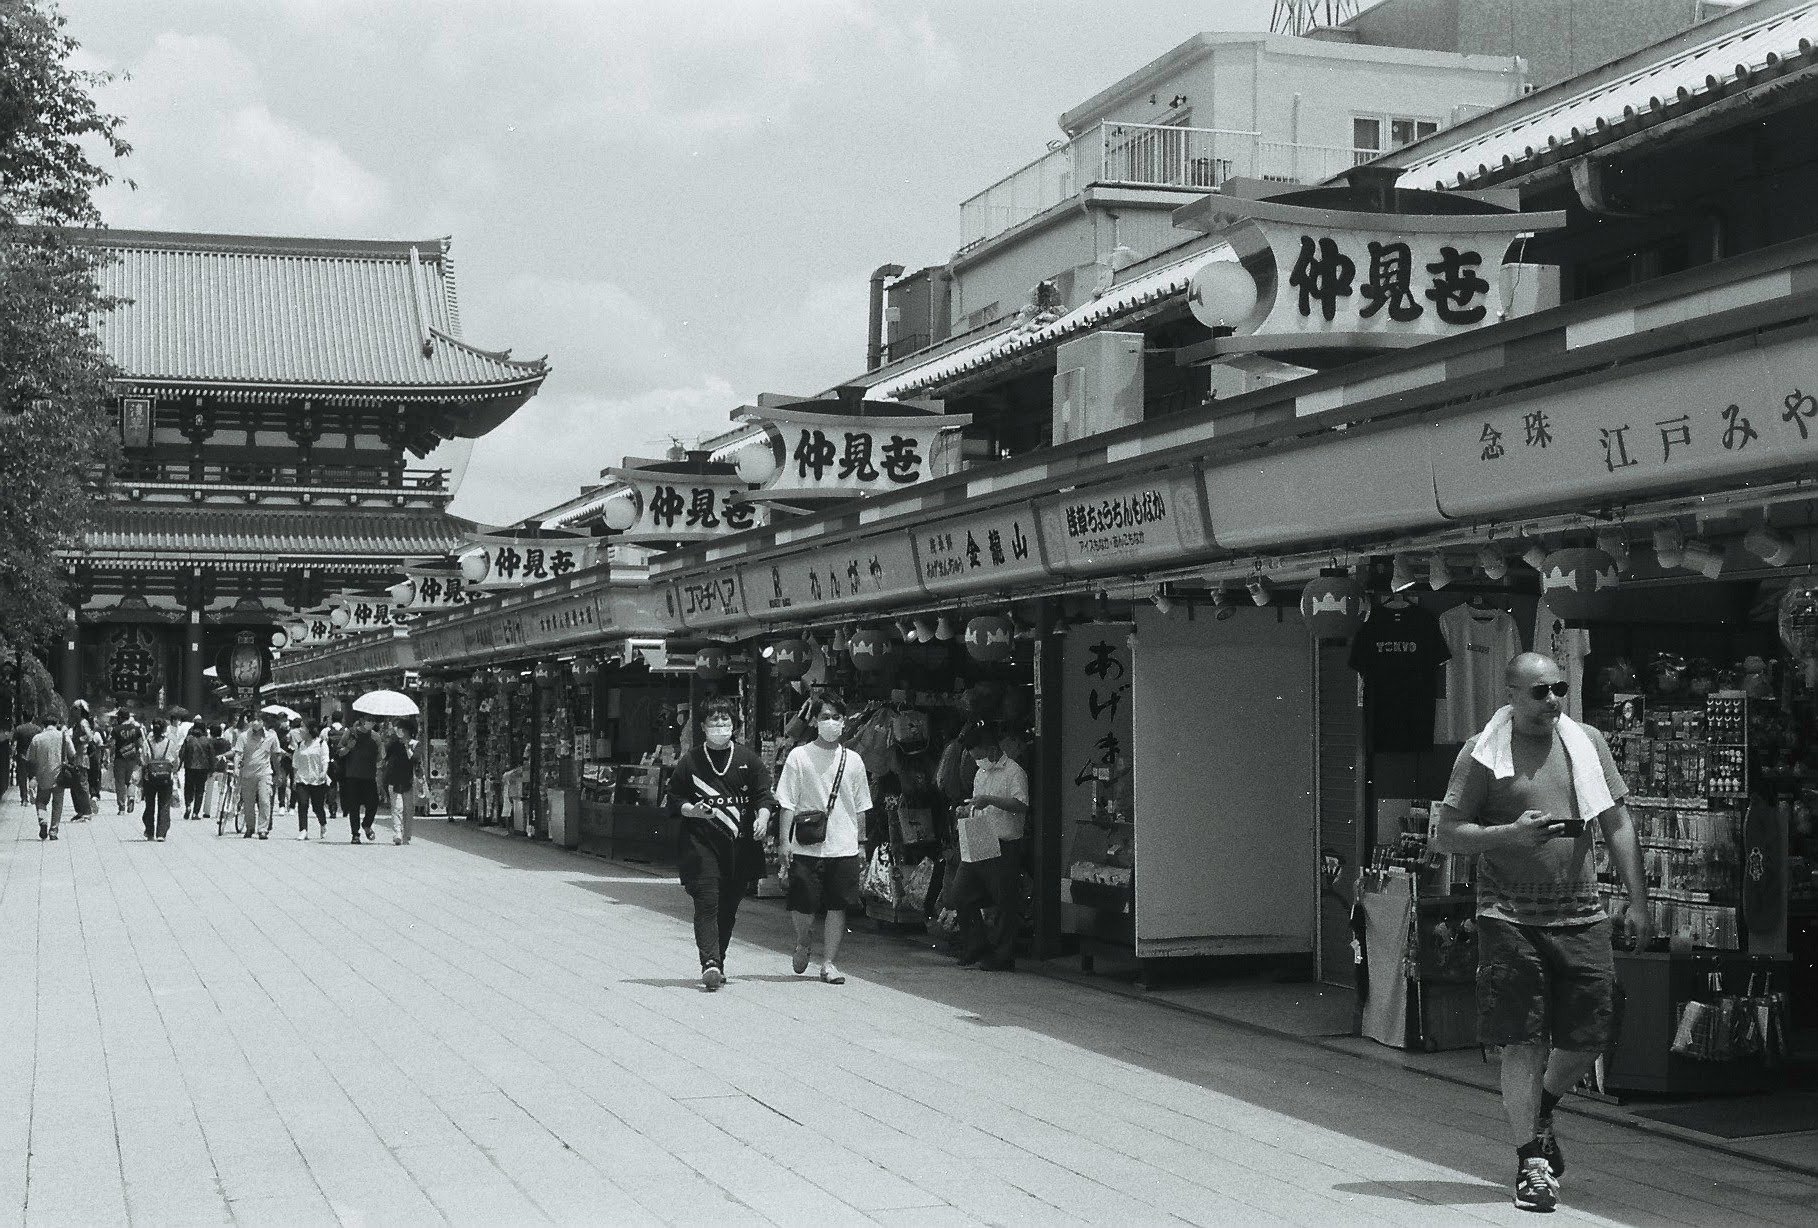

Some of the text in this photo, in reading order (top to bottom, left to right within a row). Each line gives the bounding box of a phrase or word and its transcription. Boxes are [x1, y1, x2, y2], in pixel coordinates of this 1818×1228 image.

[1289, 234, 1491, 325] 仲見世
[793, 429, 923, 484] 仲見世
[1479, 410, 1553, 461] 念珠
[1376, 640, 1417, 653] TOKYO
